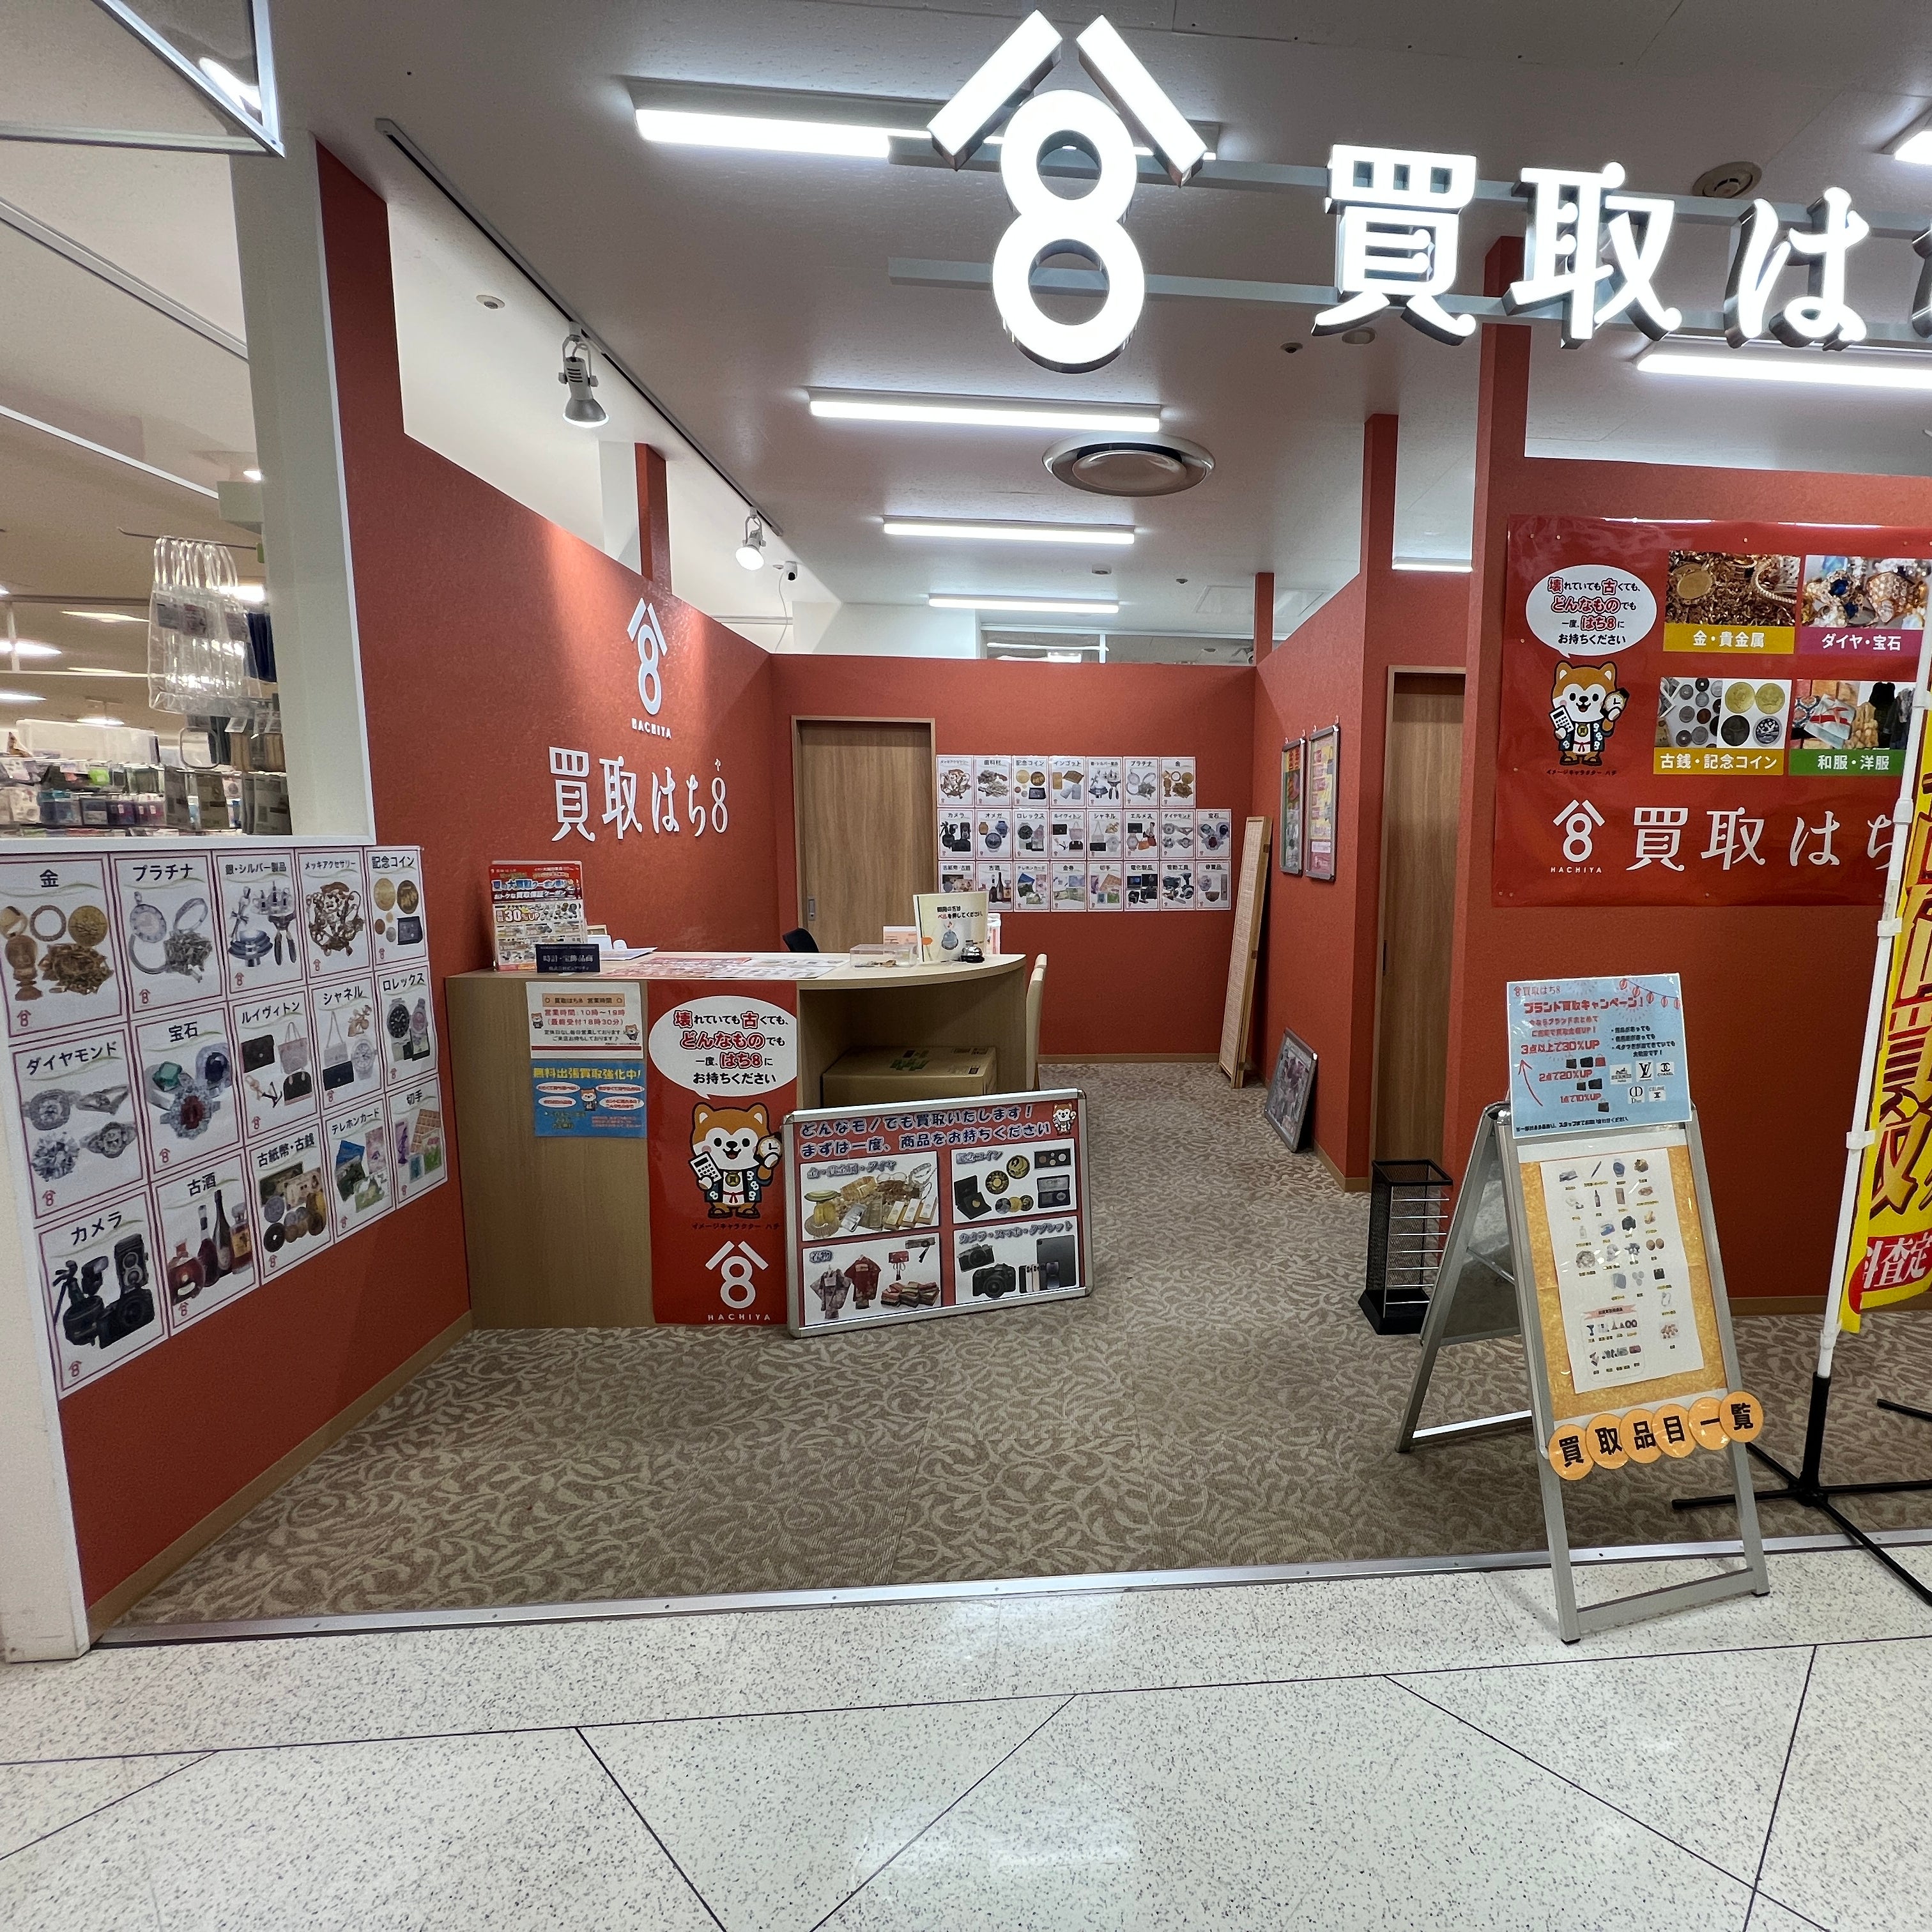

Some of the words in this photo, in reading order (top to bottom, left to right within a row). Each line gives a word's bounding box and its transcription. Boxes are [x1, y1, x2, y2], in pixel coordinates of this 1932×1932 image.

[1312, 143, 1932, 348] 買取は
[1551, 595, 1637, 614] どんなものでも
[1558, 633, 1626, 645] お持ちください
[1693, 630, 1765, 648] 金・貴金属
[1821, 634, 1901, 651] ダイヤ・宝石
[631, 717, 671, 739] HACHIYA
[1660, 754, 1777, 769] 古銭・記念コイン
[1818, 755, 1889, 770] 和服・洋服
[548, 746, 729, 842] 買取はち8
[371, 855, 415, 869] 記念コイン
[40, 869, 59, 887] 金
[133, 864, 194, 882] プラチナ
[383, 972, 425, 991] ロレックス
[323, 986, 363, 1005] シャネル
[241, 1002, 300, 1023] ルイヴィトン
[673, 1009, 788, 1029] 壊れていても古くても、
[169, 1022, 198, 1042] 宝石
[680, 1030, 785, 1050] どんなものでも
[27, 1041, 117, 1075] ダイヤモンド
[696, 1052, 773, 1069] 一度、はち8に
[693, 1073, 776, 1084] お持ちください
[406, 1091, 422, 1106] 切手
[331, 1108, 379, 1135] テレホンカード
[257, 1133, 315, 1168] 古紙幣・古銭
[187, 1172, 217, 1195] 古酒
[71, 1212, 123, 1245] カメラ
